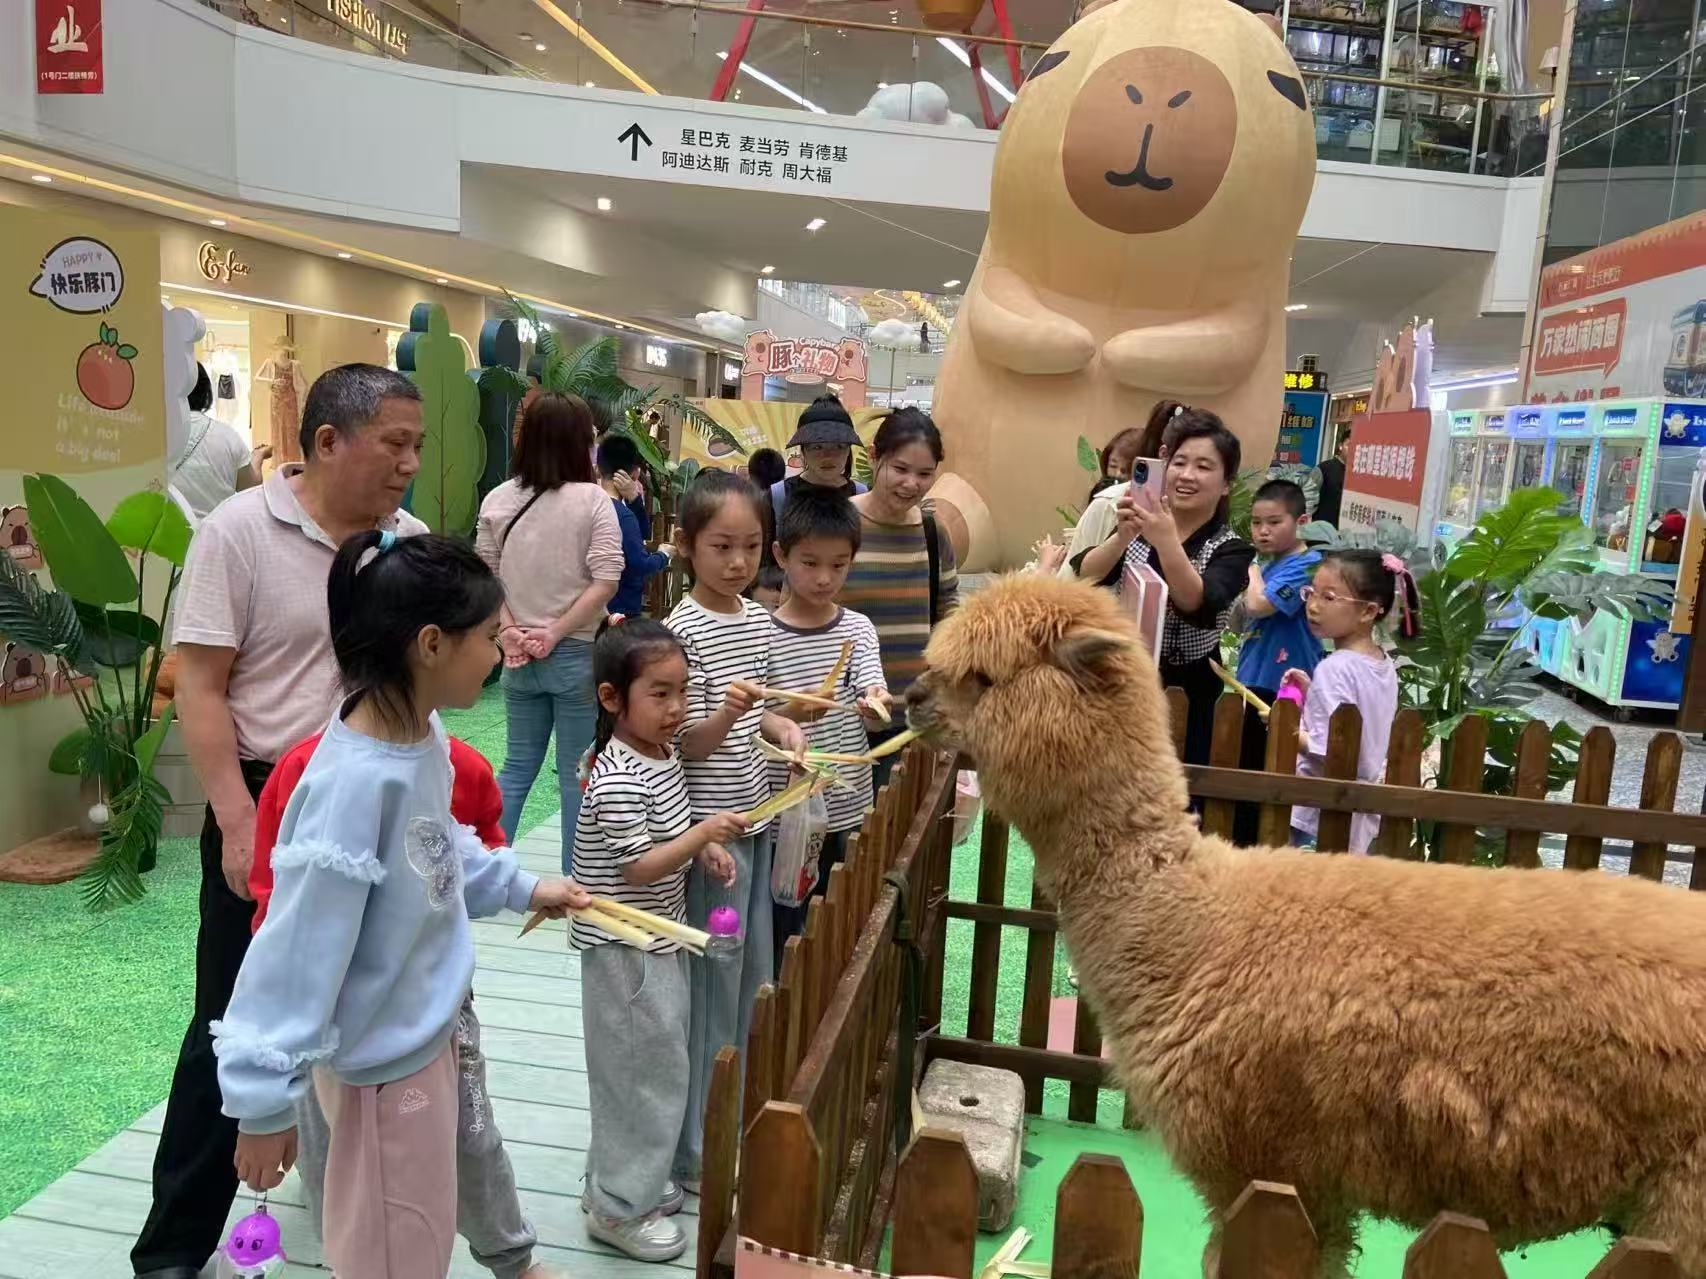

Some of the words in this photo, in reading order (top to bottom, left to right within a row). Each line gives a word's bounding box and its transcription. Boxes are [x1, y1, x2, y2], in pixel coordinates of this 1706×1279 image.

[681, 128, 730, 149] 星巴克
[739, 136, 790, 156] 麦当劳
[799, 141, 848, 162] 肯德基
[662, 151, 730, 173] 阿迪达斯
[739, 159, 773, 177] 耐克
[782, 163, 832, 184] 周大福
[63, 252, 93, 268] HAPPY
[51, 272, 116, 295] 快乐豚门
